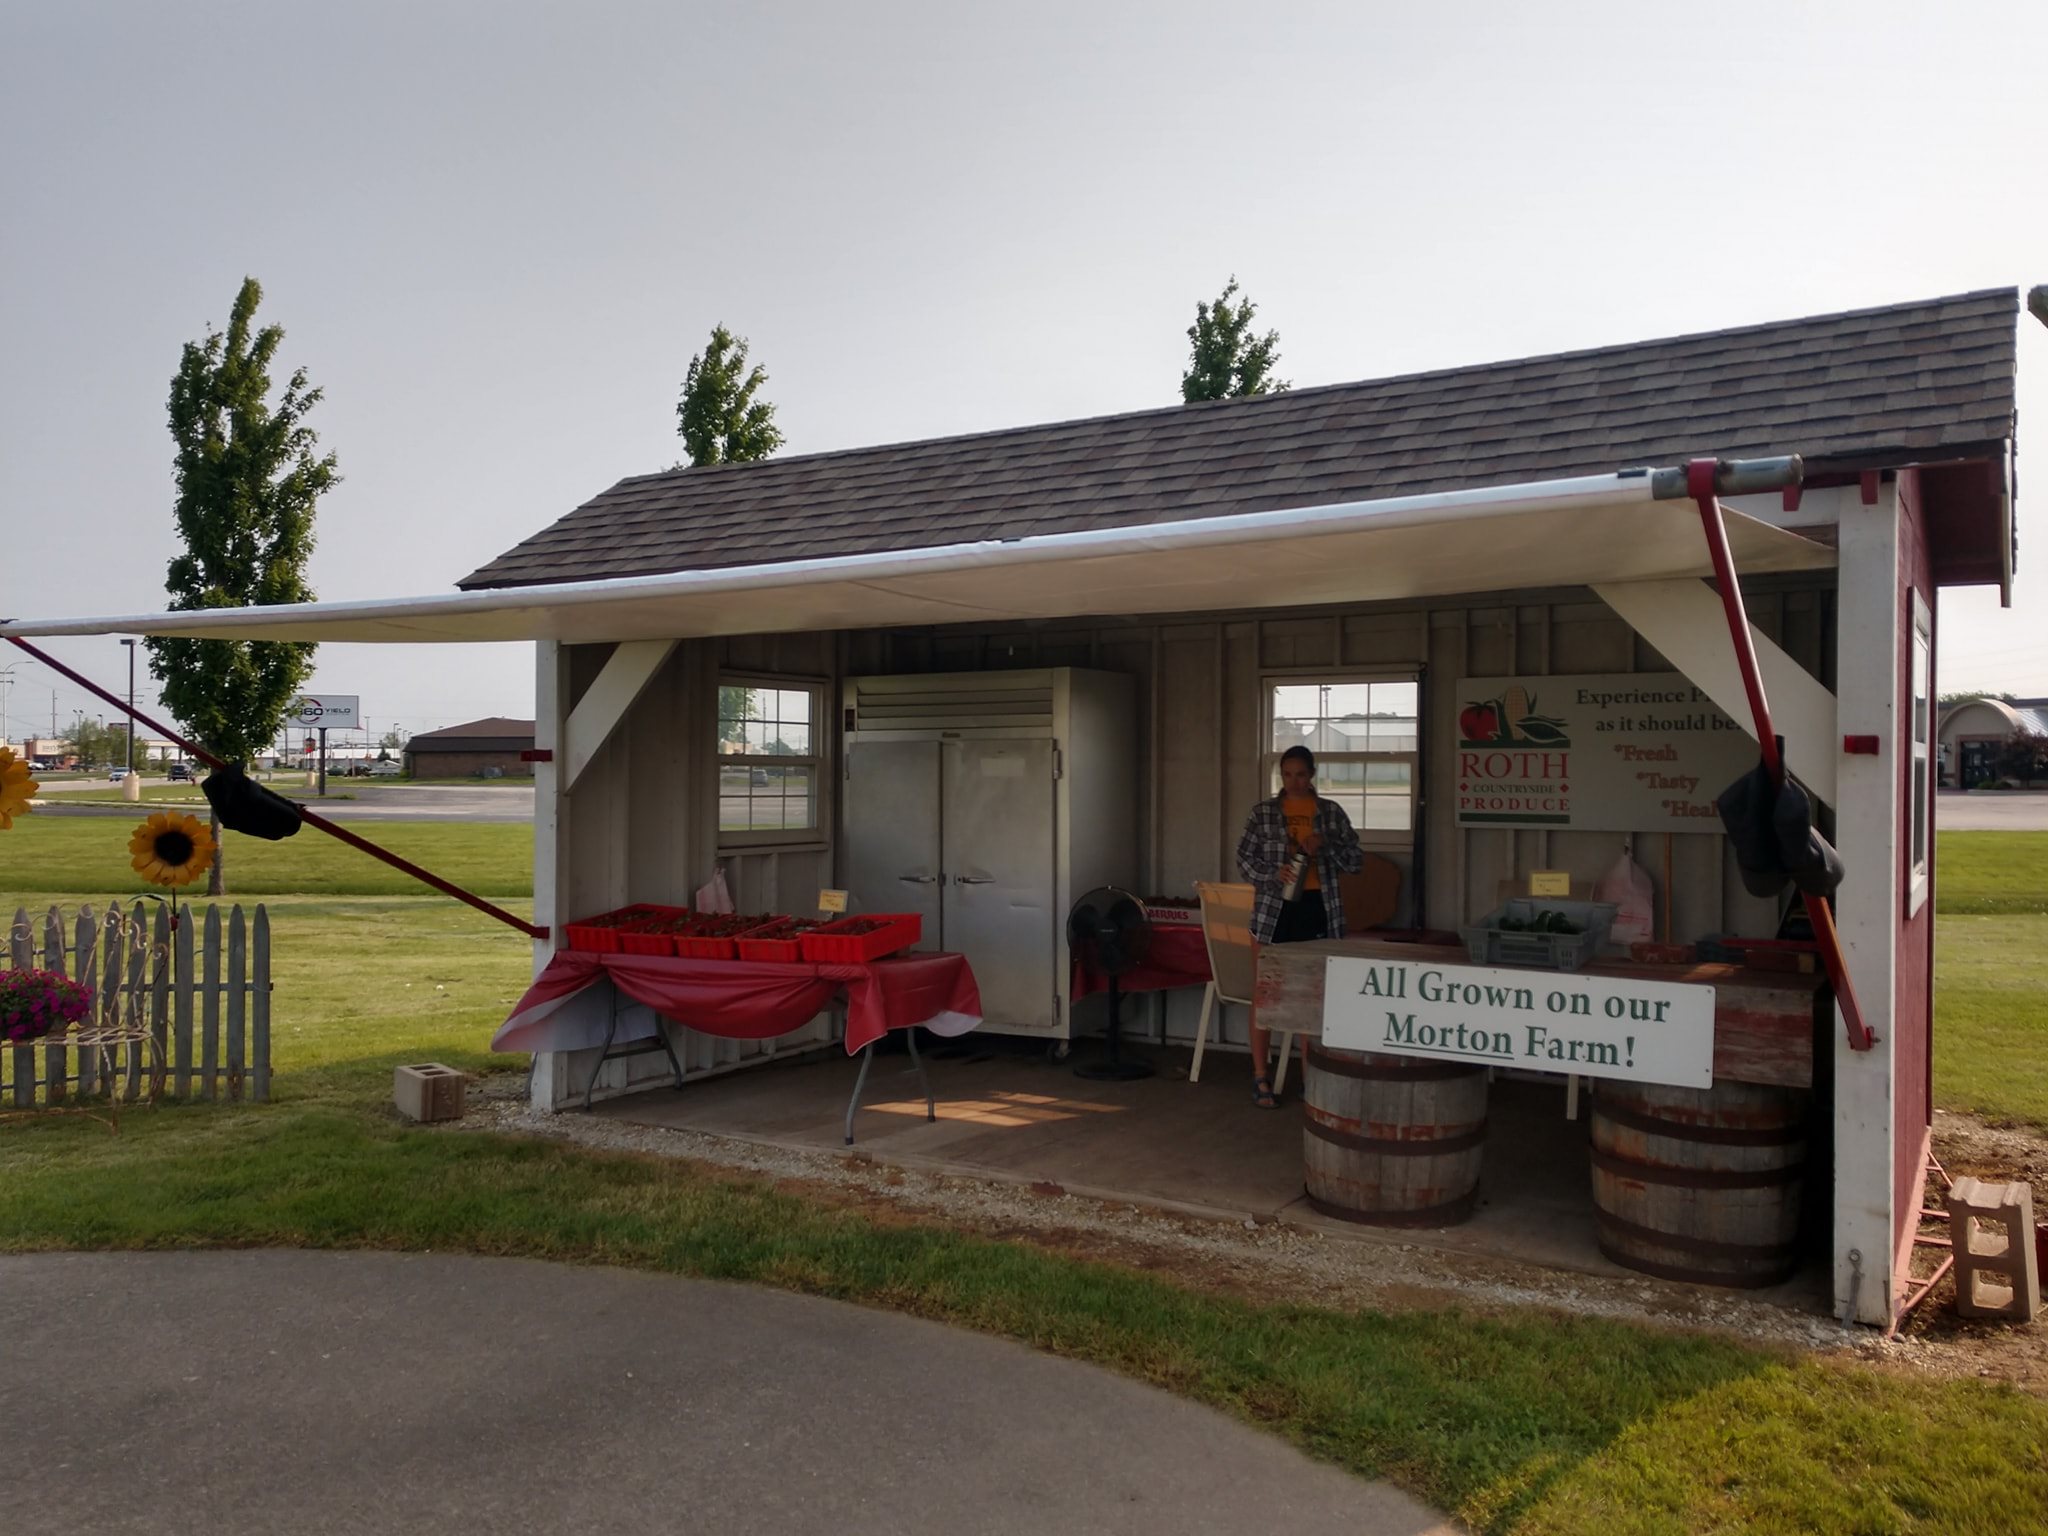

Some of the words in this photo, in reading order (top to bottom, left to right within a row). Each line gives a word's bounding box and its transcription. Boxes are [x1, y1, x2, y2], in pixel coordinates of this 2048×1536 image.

[1575, 688, 1686, 709] Experience
[1596, 719, 1615, 731] as
[1619, 716, 1633, 731] it
[1638, 714, 1706, 731] should
[1459, 752, 1570, 779] ROTH
[1472, 784, 1556, 794] COUNTRYSIDE
[1459, 797, 1570, 811] PRODUCE
[1359, 966, 1406, 998] All
[1417, 970, 1536, 1011] Grown
[1546, 989, 1592, 1016] on
[1604, 996, 1671, 1023] our
[1383, 1012, 1514, 1056] Morton
[1524, 1024, 1636, 1068] Farm!
